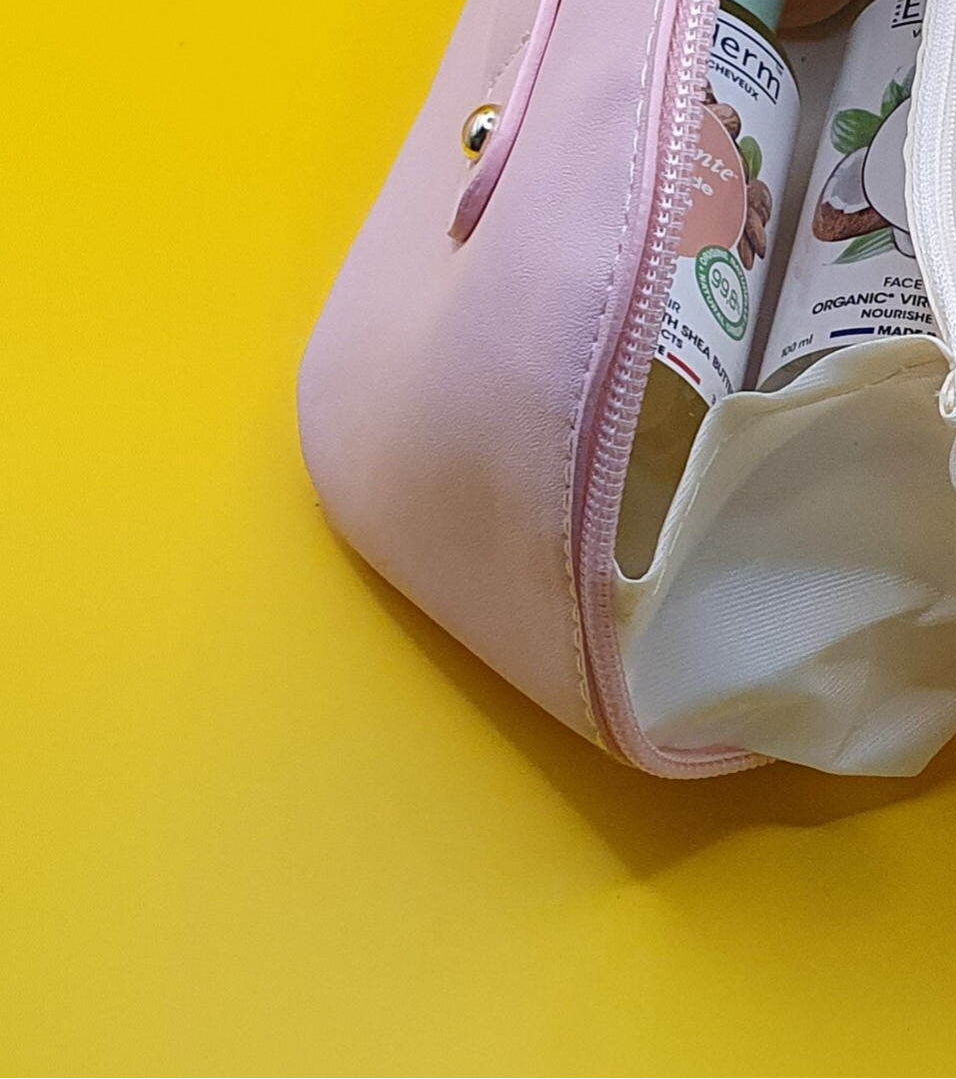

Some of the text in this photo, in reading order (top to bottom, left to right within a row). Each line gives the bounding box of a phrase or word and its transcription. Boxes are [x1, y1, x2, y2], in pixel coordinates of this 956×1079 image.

[707, 58, 760, 101] CHEVEUX
[883, 276, 924, 291] FACE
[860, 308, 934, 325] NOURISHE
[680, 324, 711, 361] SHEA
